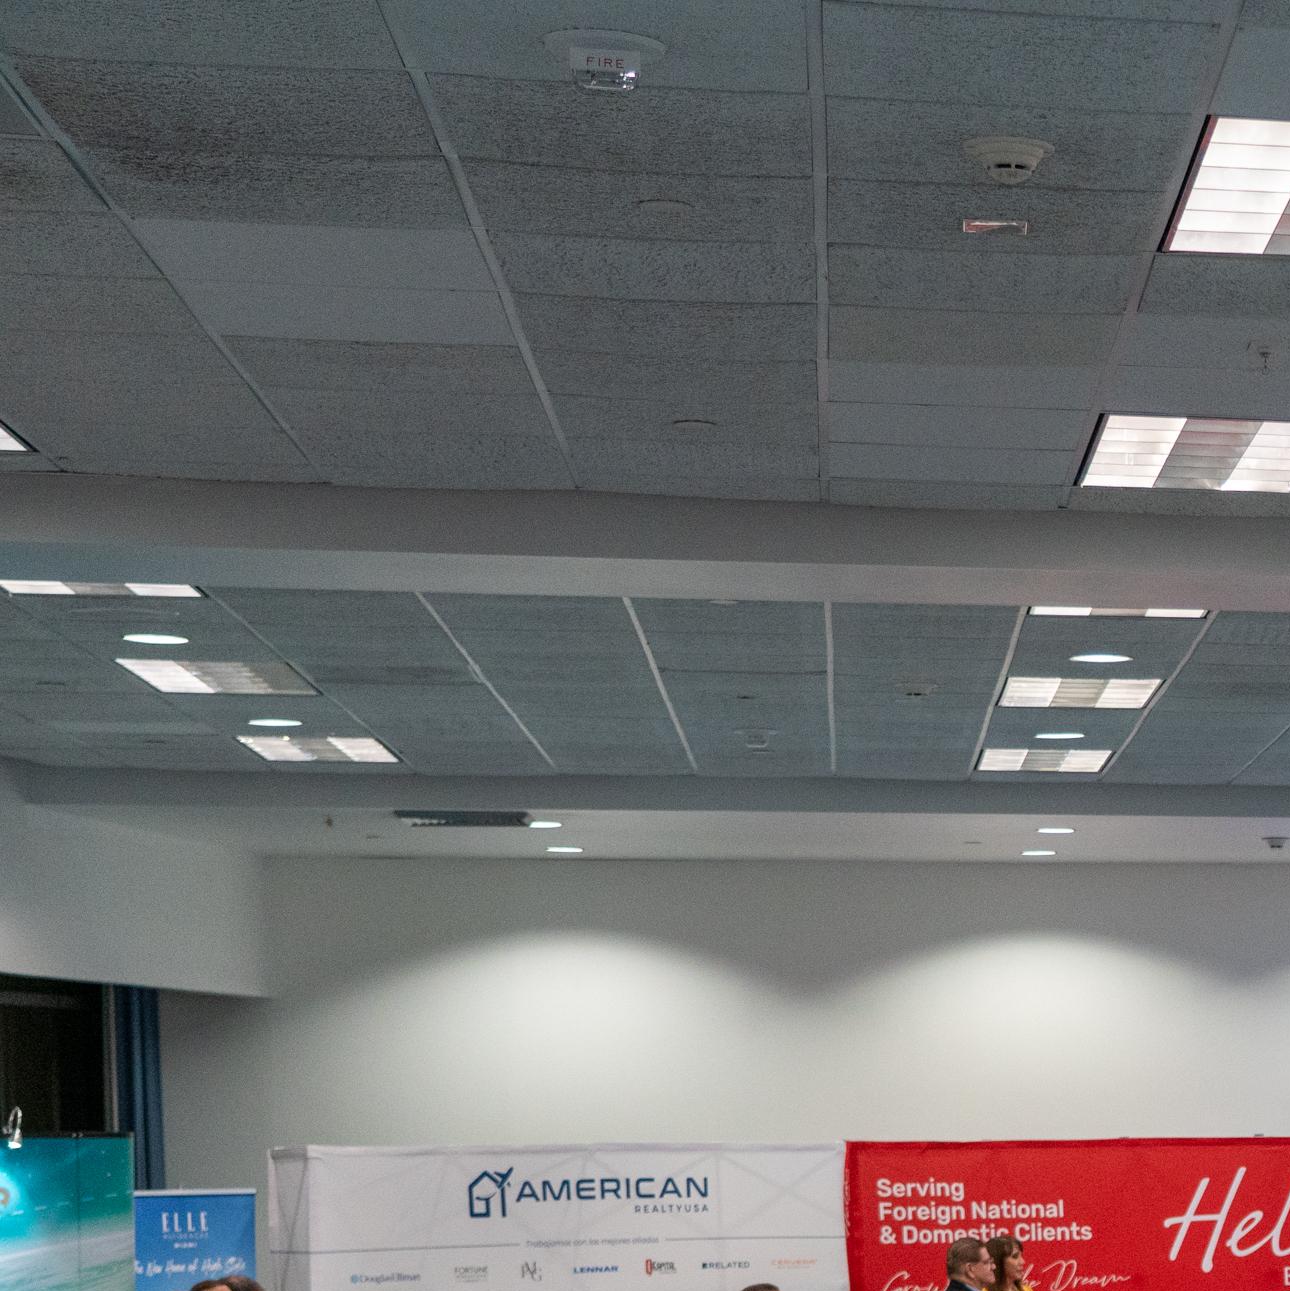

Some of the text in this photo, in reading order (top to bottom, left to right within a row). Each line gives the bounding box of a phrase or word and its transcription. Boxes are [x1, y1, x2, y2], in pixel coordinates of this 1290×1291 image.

[586, 56, 625, 69] FIRE
[515, 1176, 710, 1203] AMERICAN
[875, 1177, 966, 1202] Serving
[634, 1204, 710, 1214] REALTYUSA
[878, 1199, 1065, 1226] Foreign National
[161, 1211, 209, 1233] ELLE
[879, 1225, 897, 1245] &
[1014, 1221, 1093, 1243] Clients
[573, 1265, 620, 1275] LENNAR
